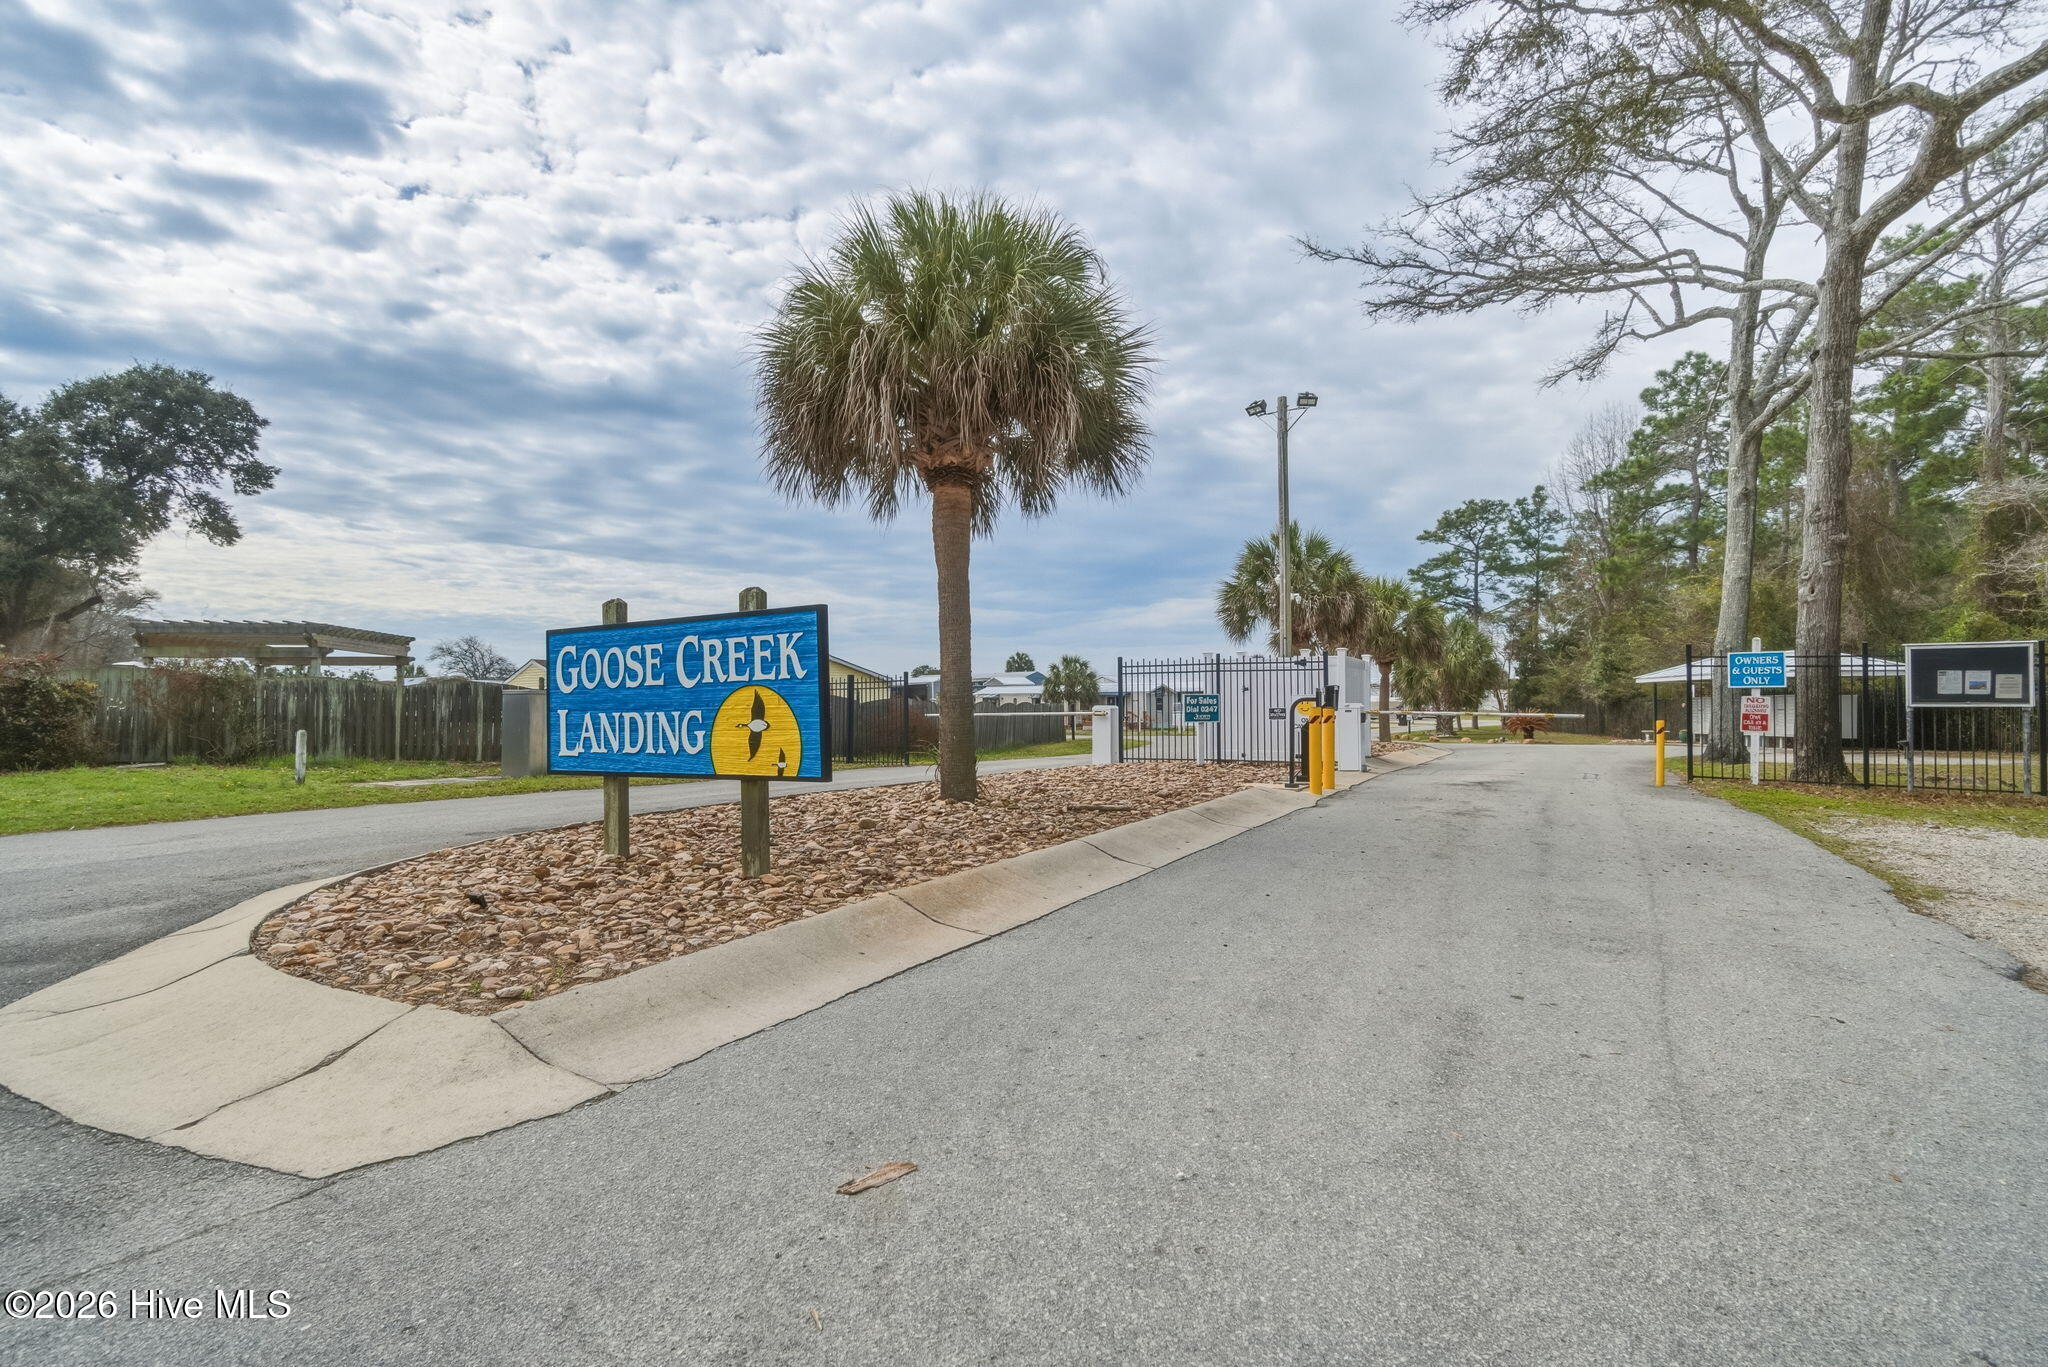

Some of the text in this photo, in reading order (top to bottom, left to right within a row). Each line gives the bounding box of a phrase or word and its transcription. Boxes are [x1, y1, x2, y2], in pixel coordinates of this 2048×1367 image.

[556, 632, 808, 694] GOOSE CREEK
[1735, 656, 1779, 665] OWNERS
[1732, 666, 1783, 675] & GUESTS
[1742, 676, 1771, 685] ONLY
[1198, 696, 1217, 705] Sales
[1186, 705, 1218, 713] Dial 0247
[557, 709, 705, 757] LANDING
